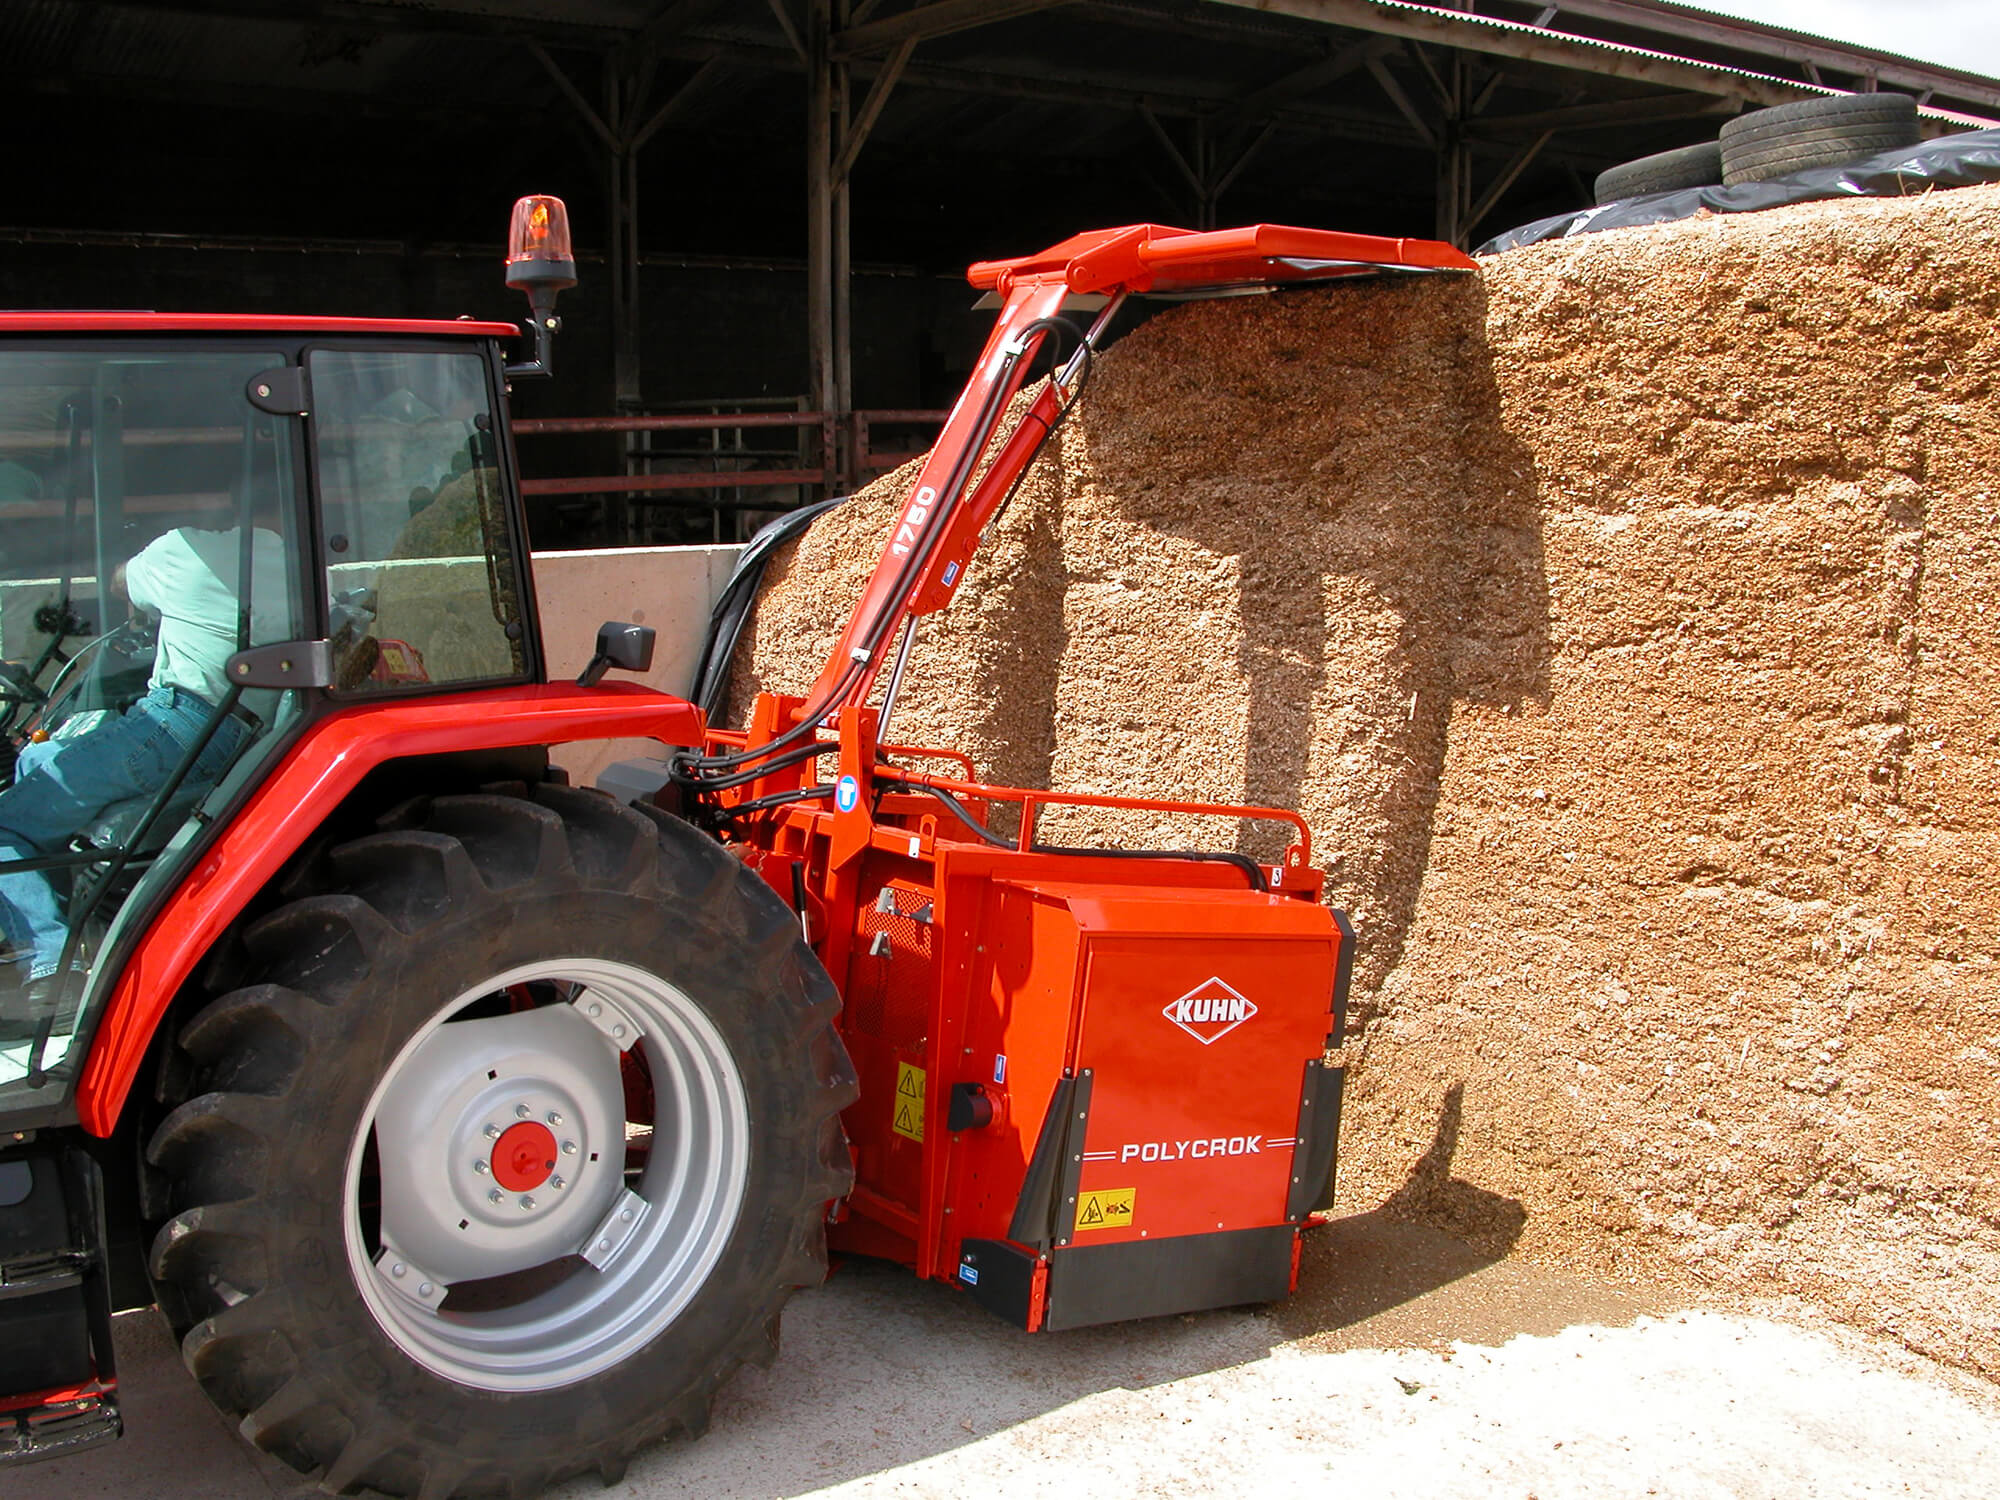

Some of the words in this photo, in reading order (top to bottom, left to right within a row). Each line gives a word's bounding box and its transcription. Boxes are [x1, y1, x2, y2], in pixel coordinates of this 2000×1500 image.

[892, 486, 936, 555] 1750
[1176, 998, 1246, 1022] KUHN
[1121, 1135, 1263, 1163] POLYCROK
